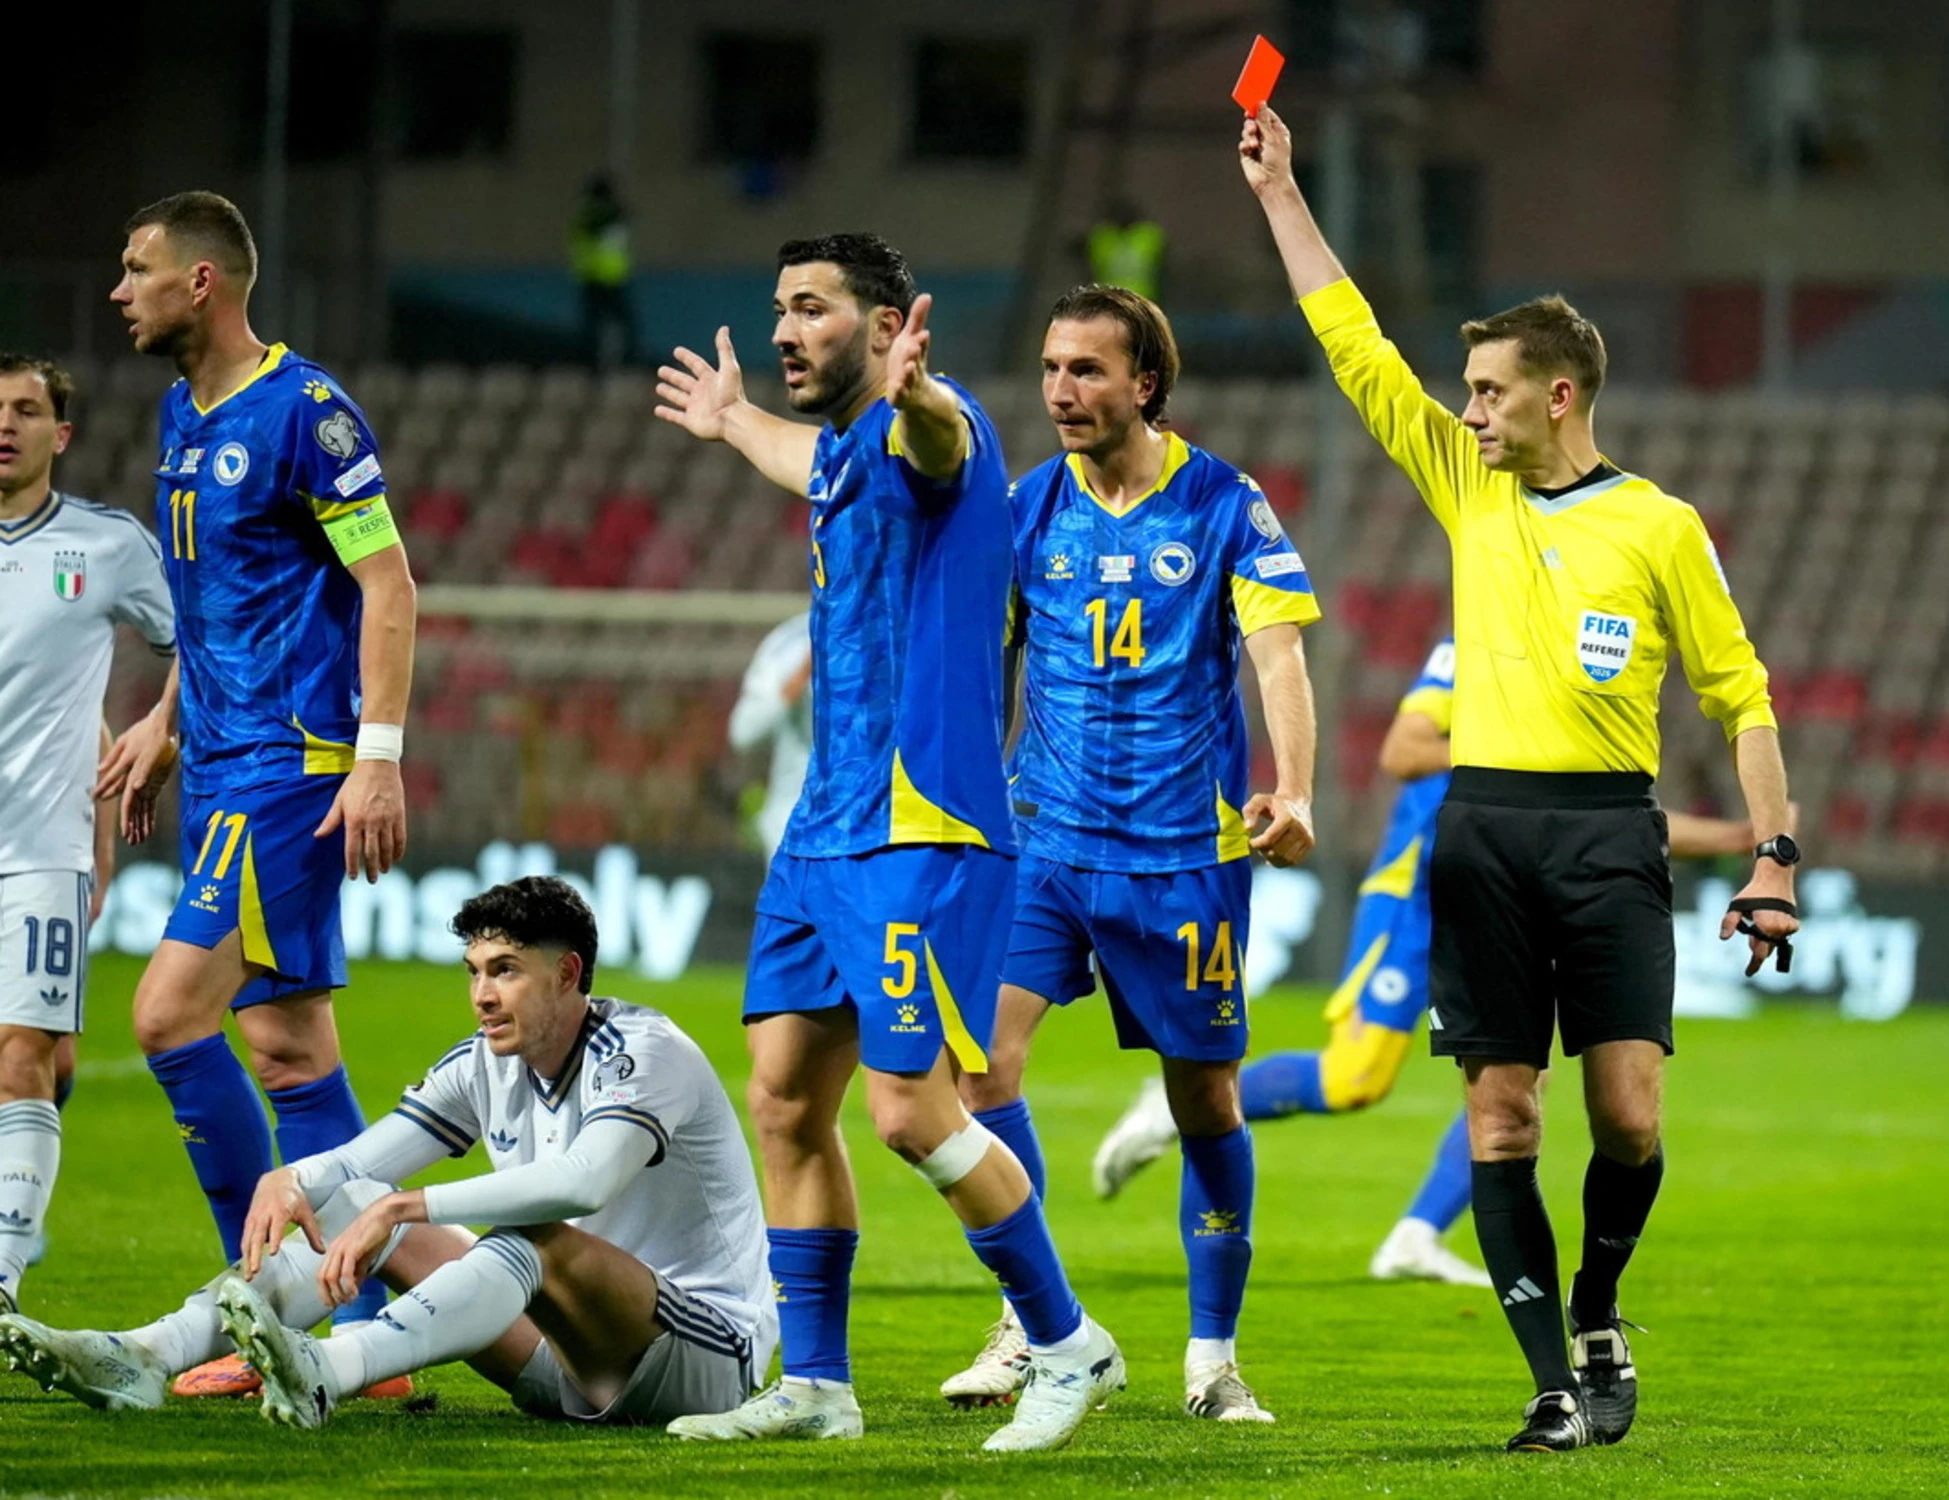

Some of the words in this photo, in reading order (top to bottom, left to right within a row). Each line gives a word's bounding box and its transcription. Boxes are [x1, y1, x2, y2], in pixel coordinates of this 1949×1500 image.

[169, 489, 196, 561] 11
[1045, 572, 1074, 580] KELME
[1085, 598, 1145, 668] 14
[1584, 615, 1629, 638] FIFA
[1580, 642, 1626, 658] REFEREE
[192, 809, 248, 880] 11
[189, 899, 220, 914] KELME
[24, 915, 73, 976] 18
[882, 922, 919, 999] 5
[1177, 921, 1236, 991] 14
[890, 1023, 926, 1033] KELME
[1210, 1017, 1240, 1026] KELME
[3, 1172, 42, 1189] TALIA
[1194, 1226, 1241, 1237] KELME
